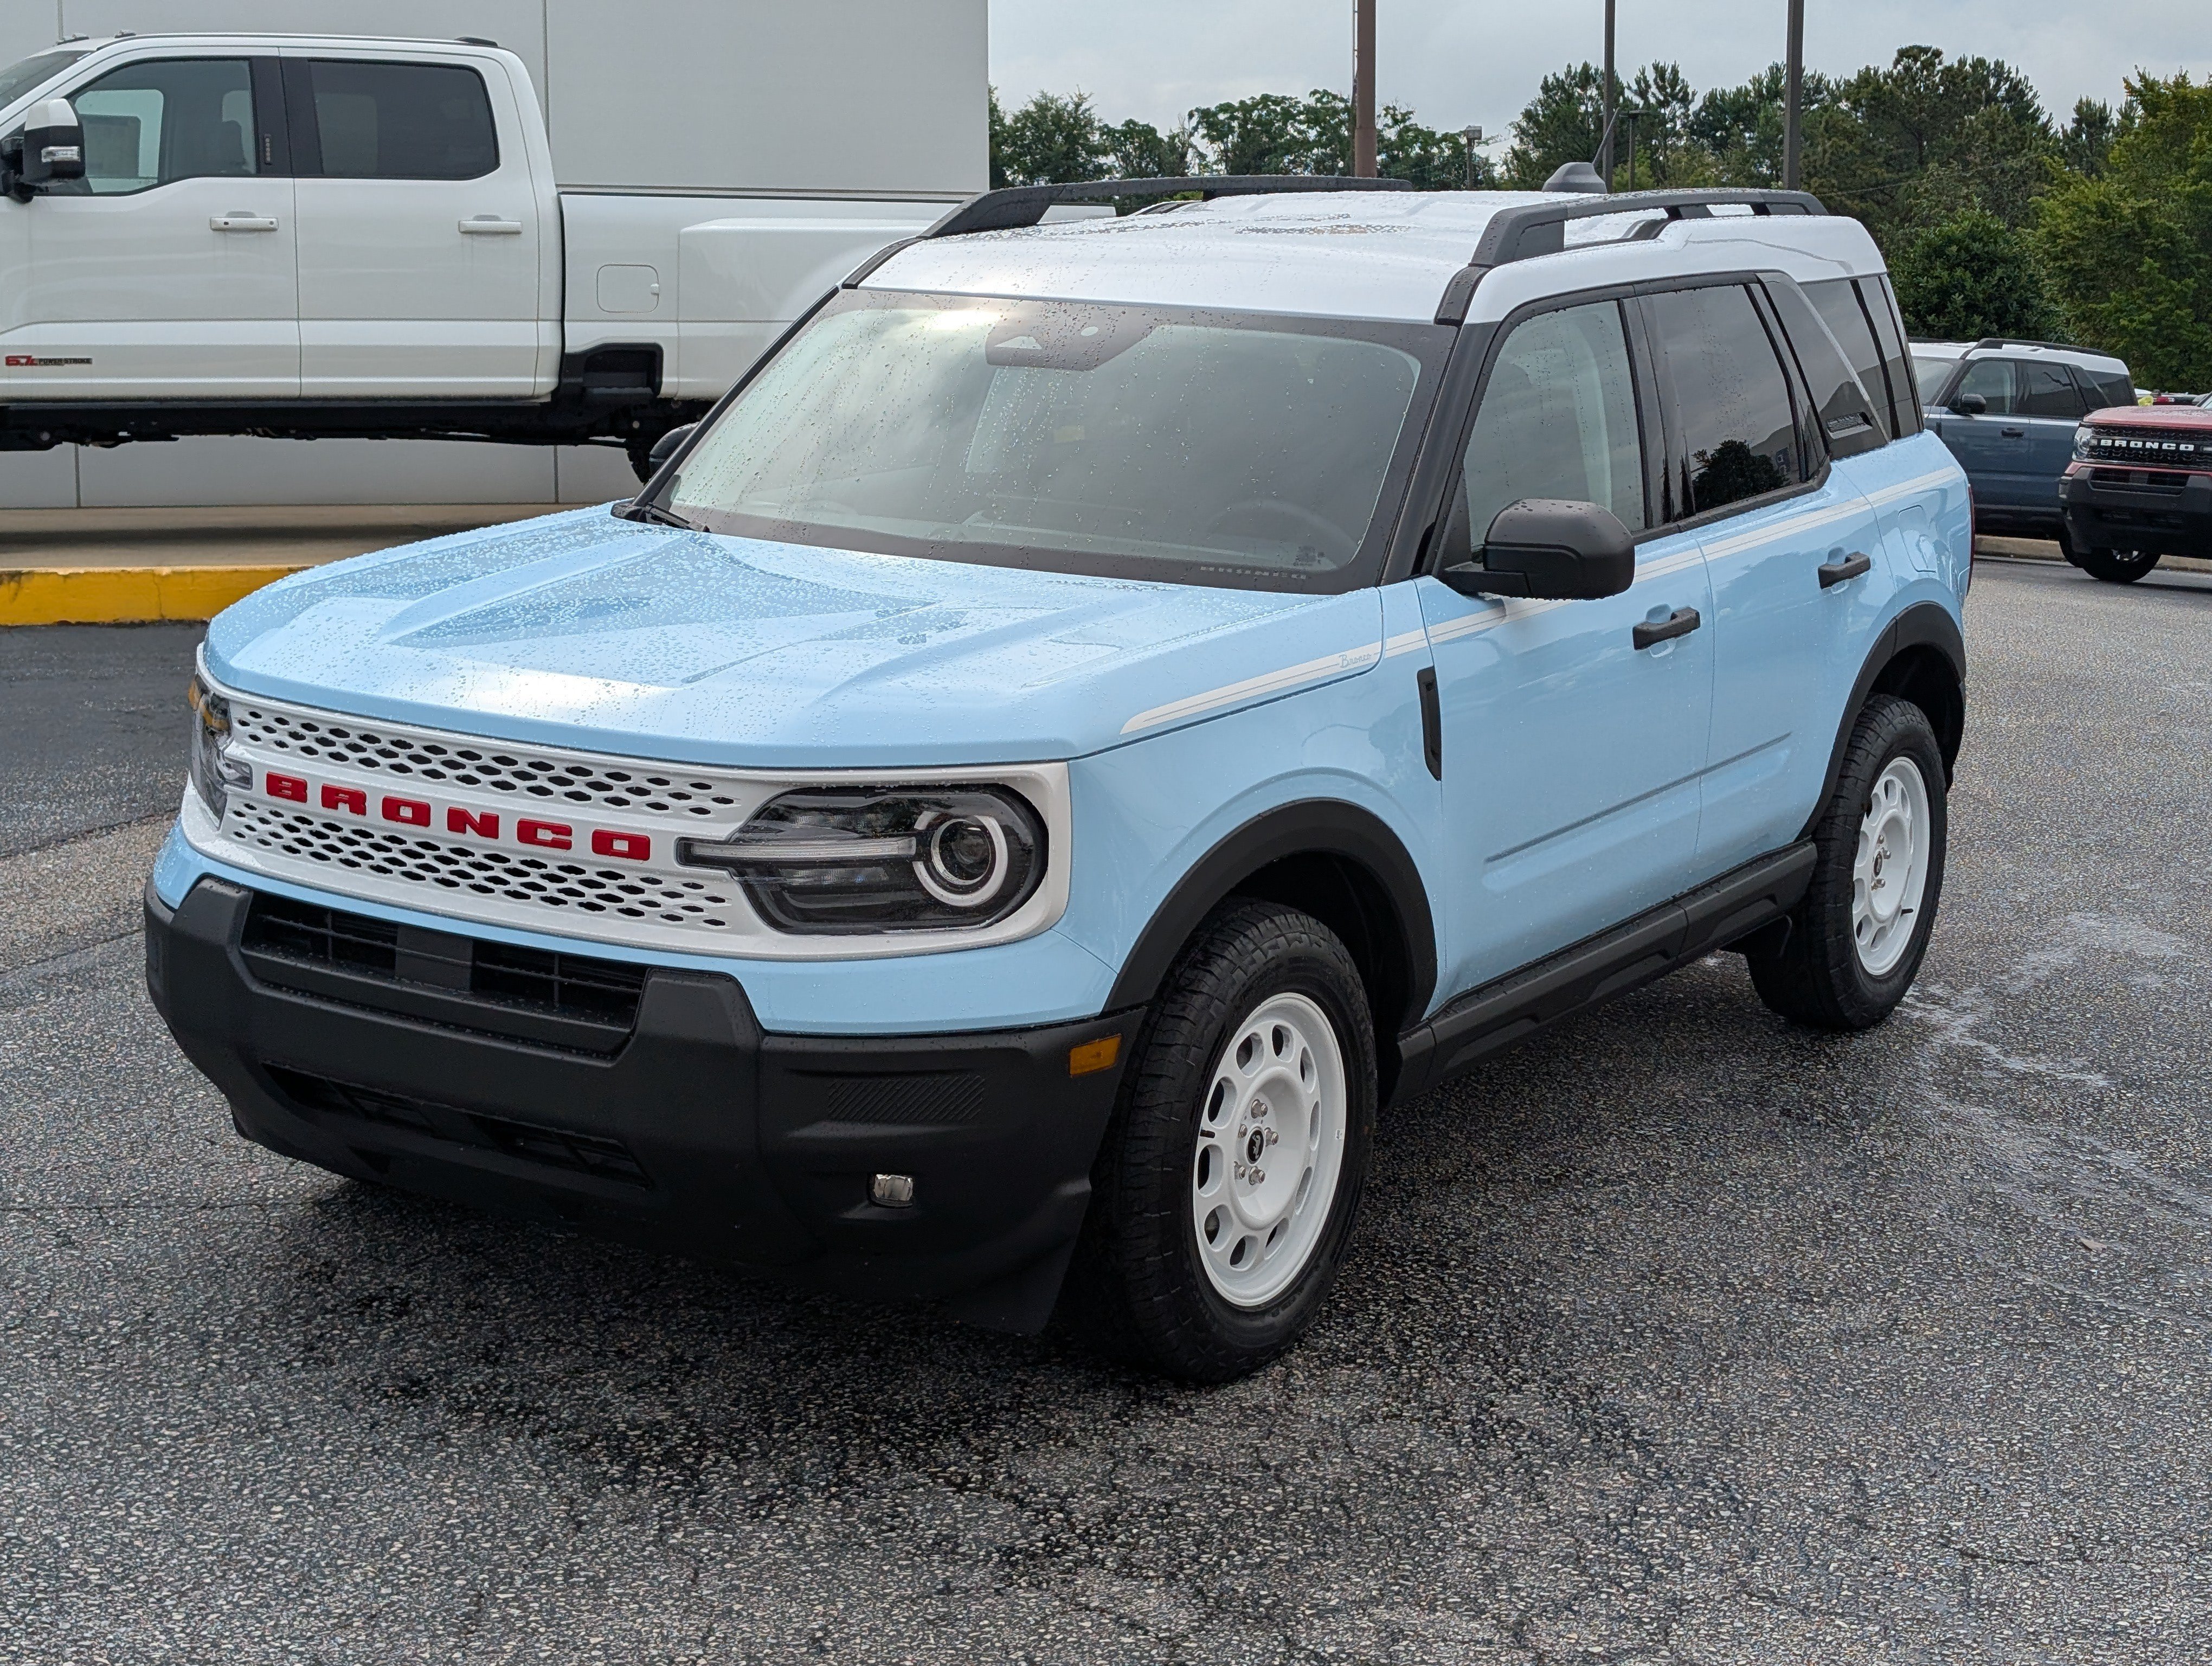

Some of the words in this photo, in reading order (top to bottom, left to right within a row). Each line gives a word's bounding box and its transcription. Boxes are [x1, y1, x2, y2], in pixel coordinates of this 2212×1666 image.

[2100, 439, 2195, 452] BRONCO
[1339, 653, 1372, 668] Bronco
[266, 771, 651, 862] BRONCO
